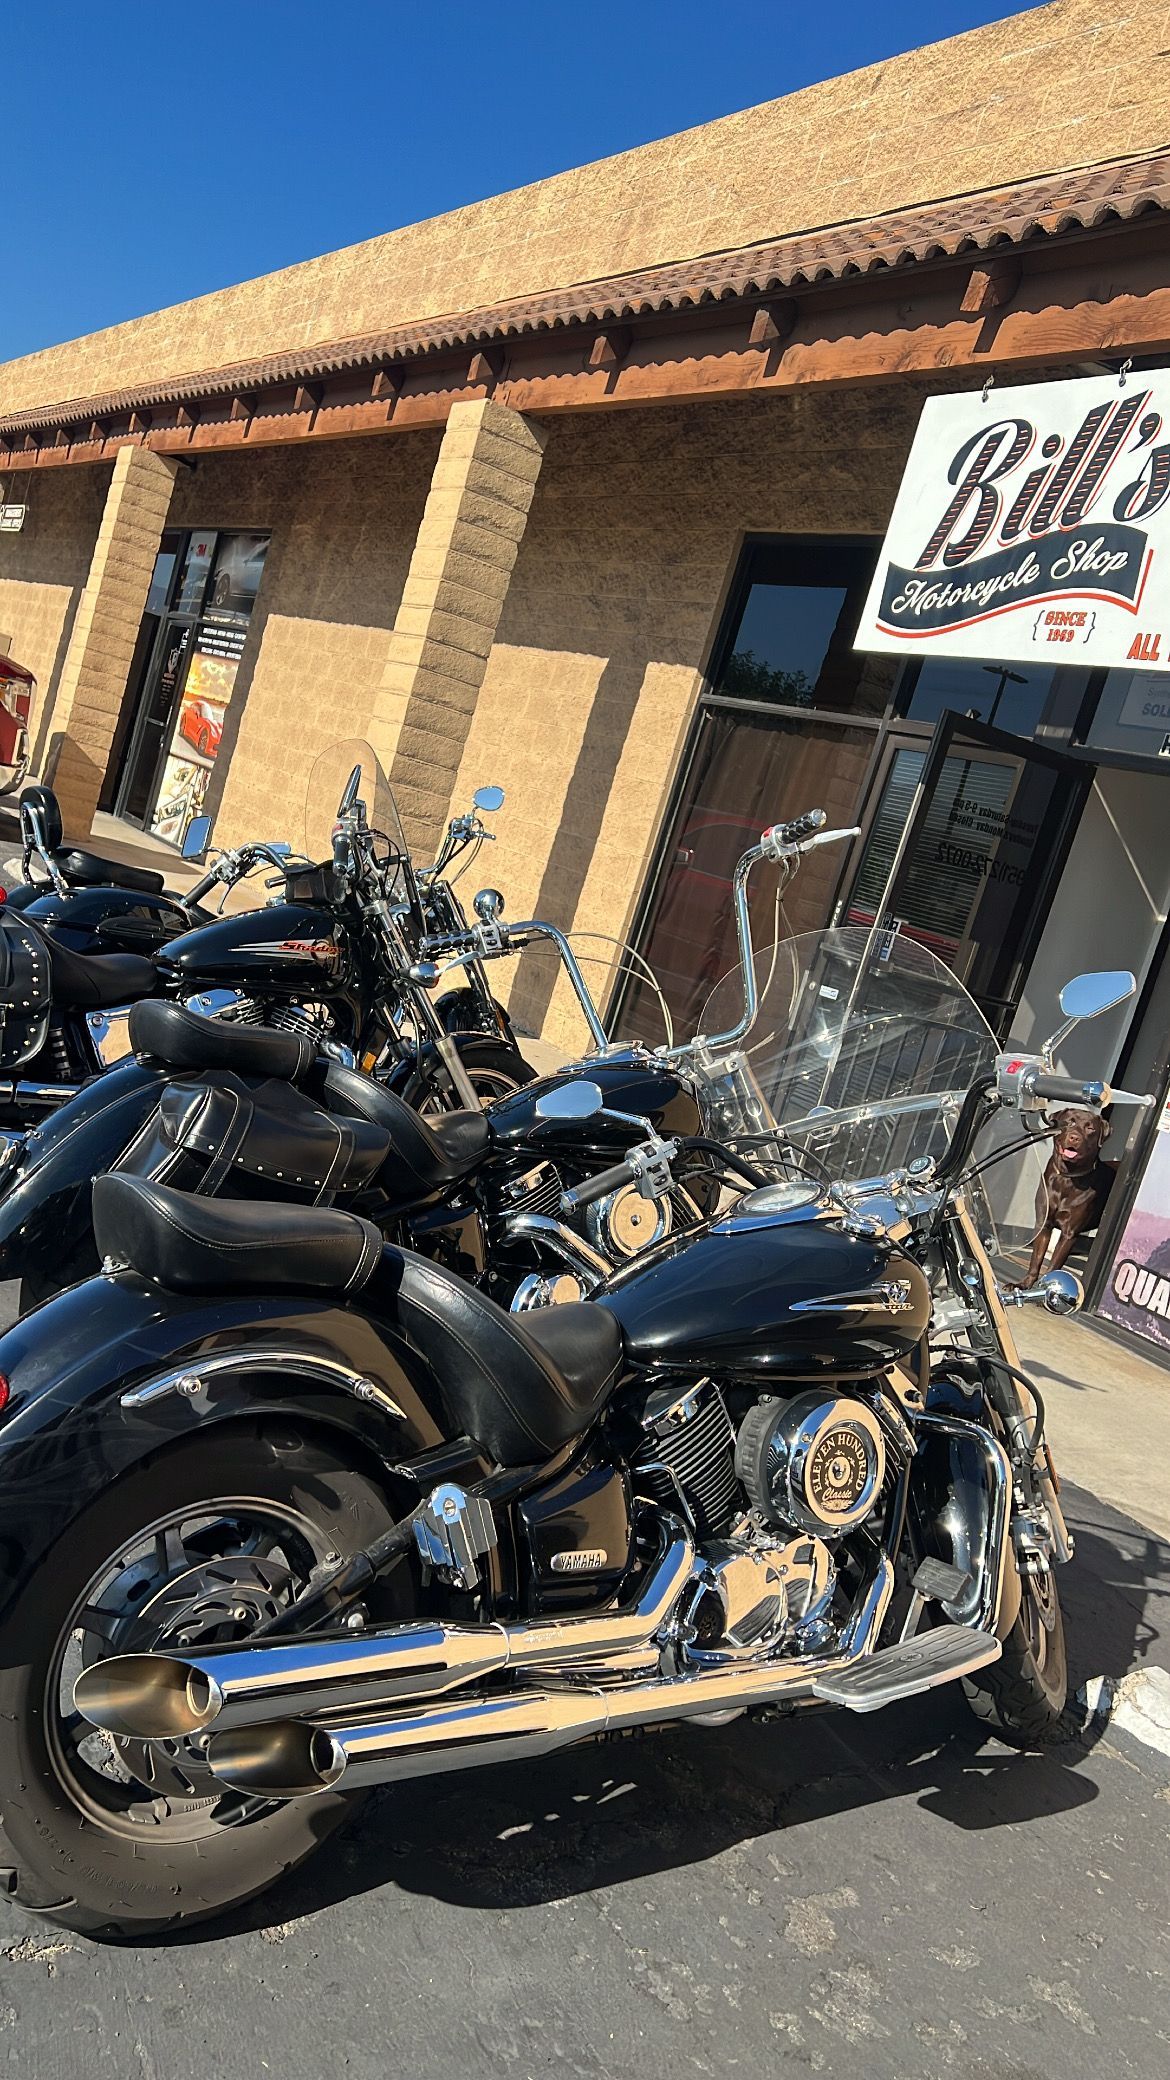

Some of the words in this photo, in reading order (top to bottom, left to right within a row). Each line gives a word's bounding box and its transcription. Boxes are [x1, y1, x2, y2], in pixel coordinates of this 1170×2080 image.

[914, 389, 1170, 570] Bill's
[891, 551, 1041, 616] Motorcycle
[1050, 536, 1129, 581] Shop
[1044, 610, 1088, 627] SINCE
[1046, 628, 1075, 643] 1969
[1126, 632, 1162, 662] ALL
[1114, 1262, 1170, 1320] QUA
[812, 1436, 836, 1494] ELEVEN
[837, 1434, 867, 1491] HUNDRED
[822, 1487, 853, 1501] Classic
[560, 1553, 602, 1570] YAMAHA
